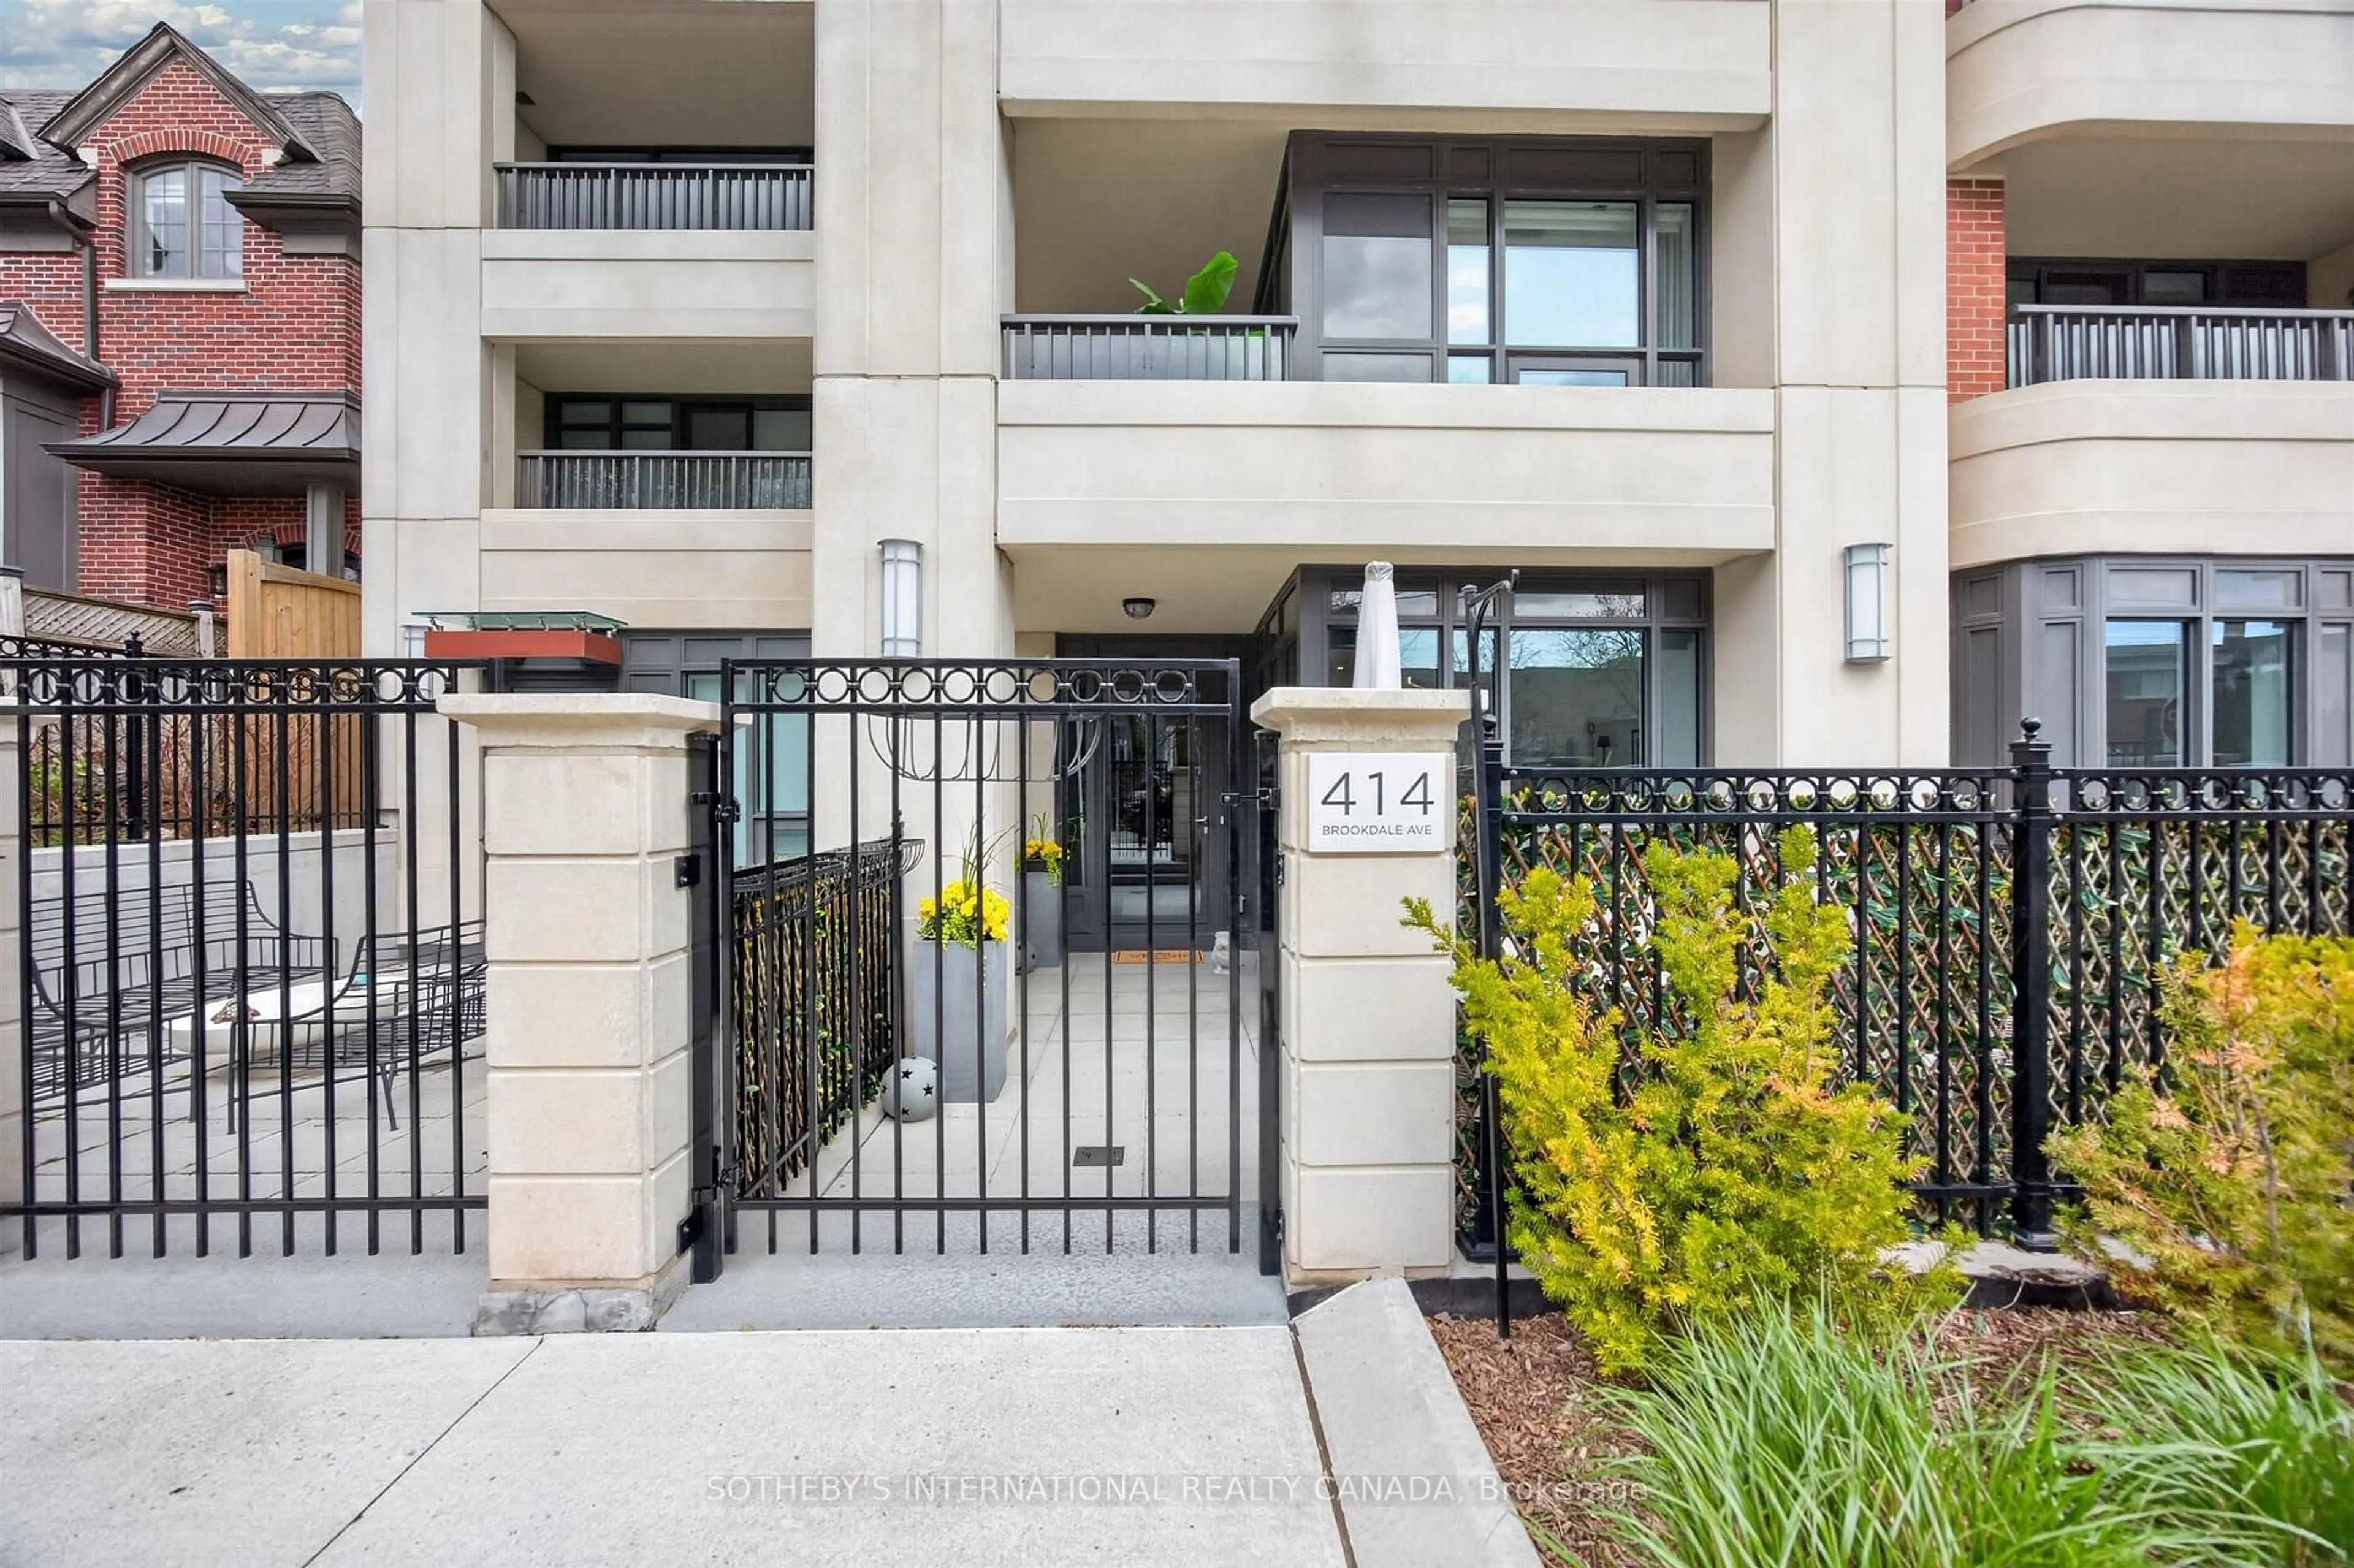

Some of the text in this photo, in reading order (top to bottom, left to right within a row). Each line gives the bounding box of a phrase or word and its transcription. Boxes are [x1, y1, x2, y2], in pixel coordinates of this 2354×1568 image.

[1321, 772, 1434, 815] 414
[1322, 825, 1432, 835] BROOKDALE AVE
